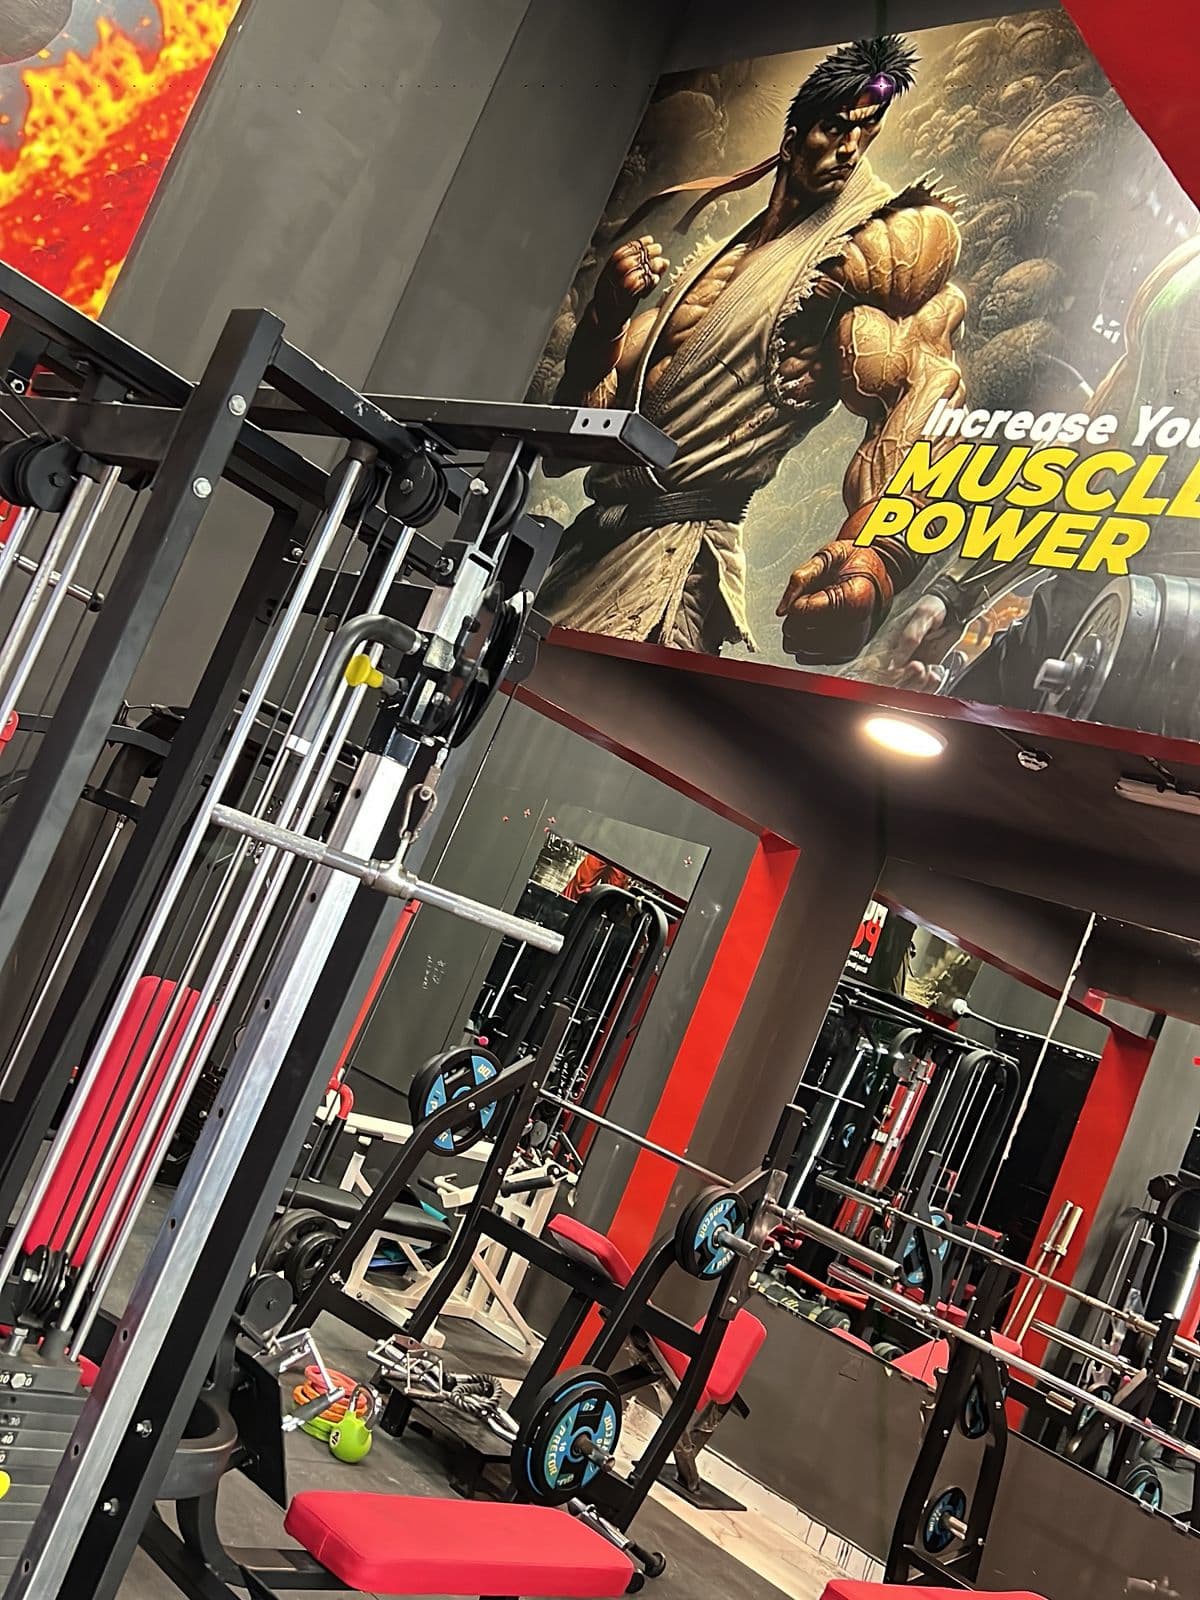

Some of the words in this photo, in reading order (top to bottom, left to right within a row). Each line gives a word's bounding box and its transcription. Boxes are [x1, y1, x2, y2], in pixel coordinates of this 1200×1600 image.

[921, 398, 1118, 445] Increase
[853, 497, 1151, 575] POWER
[1, 1433, 14, 1444] 40
